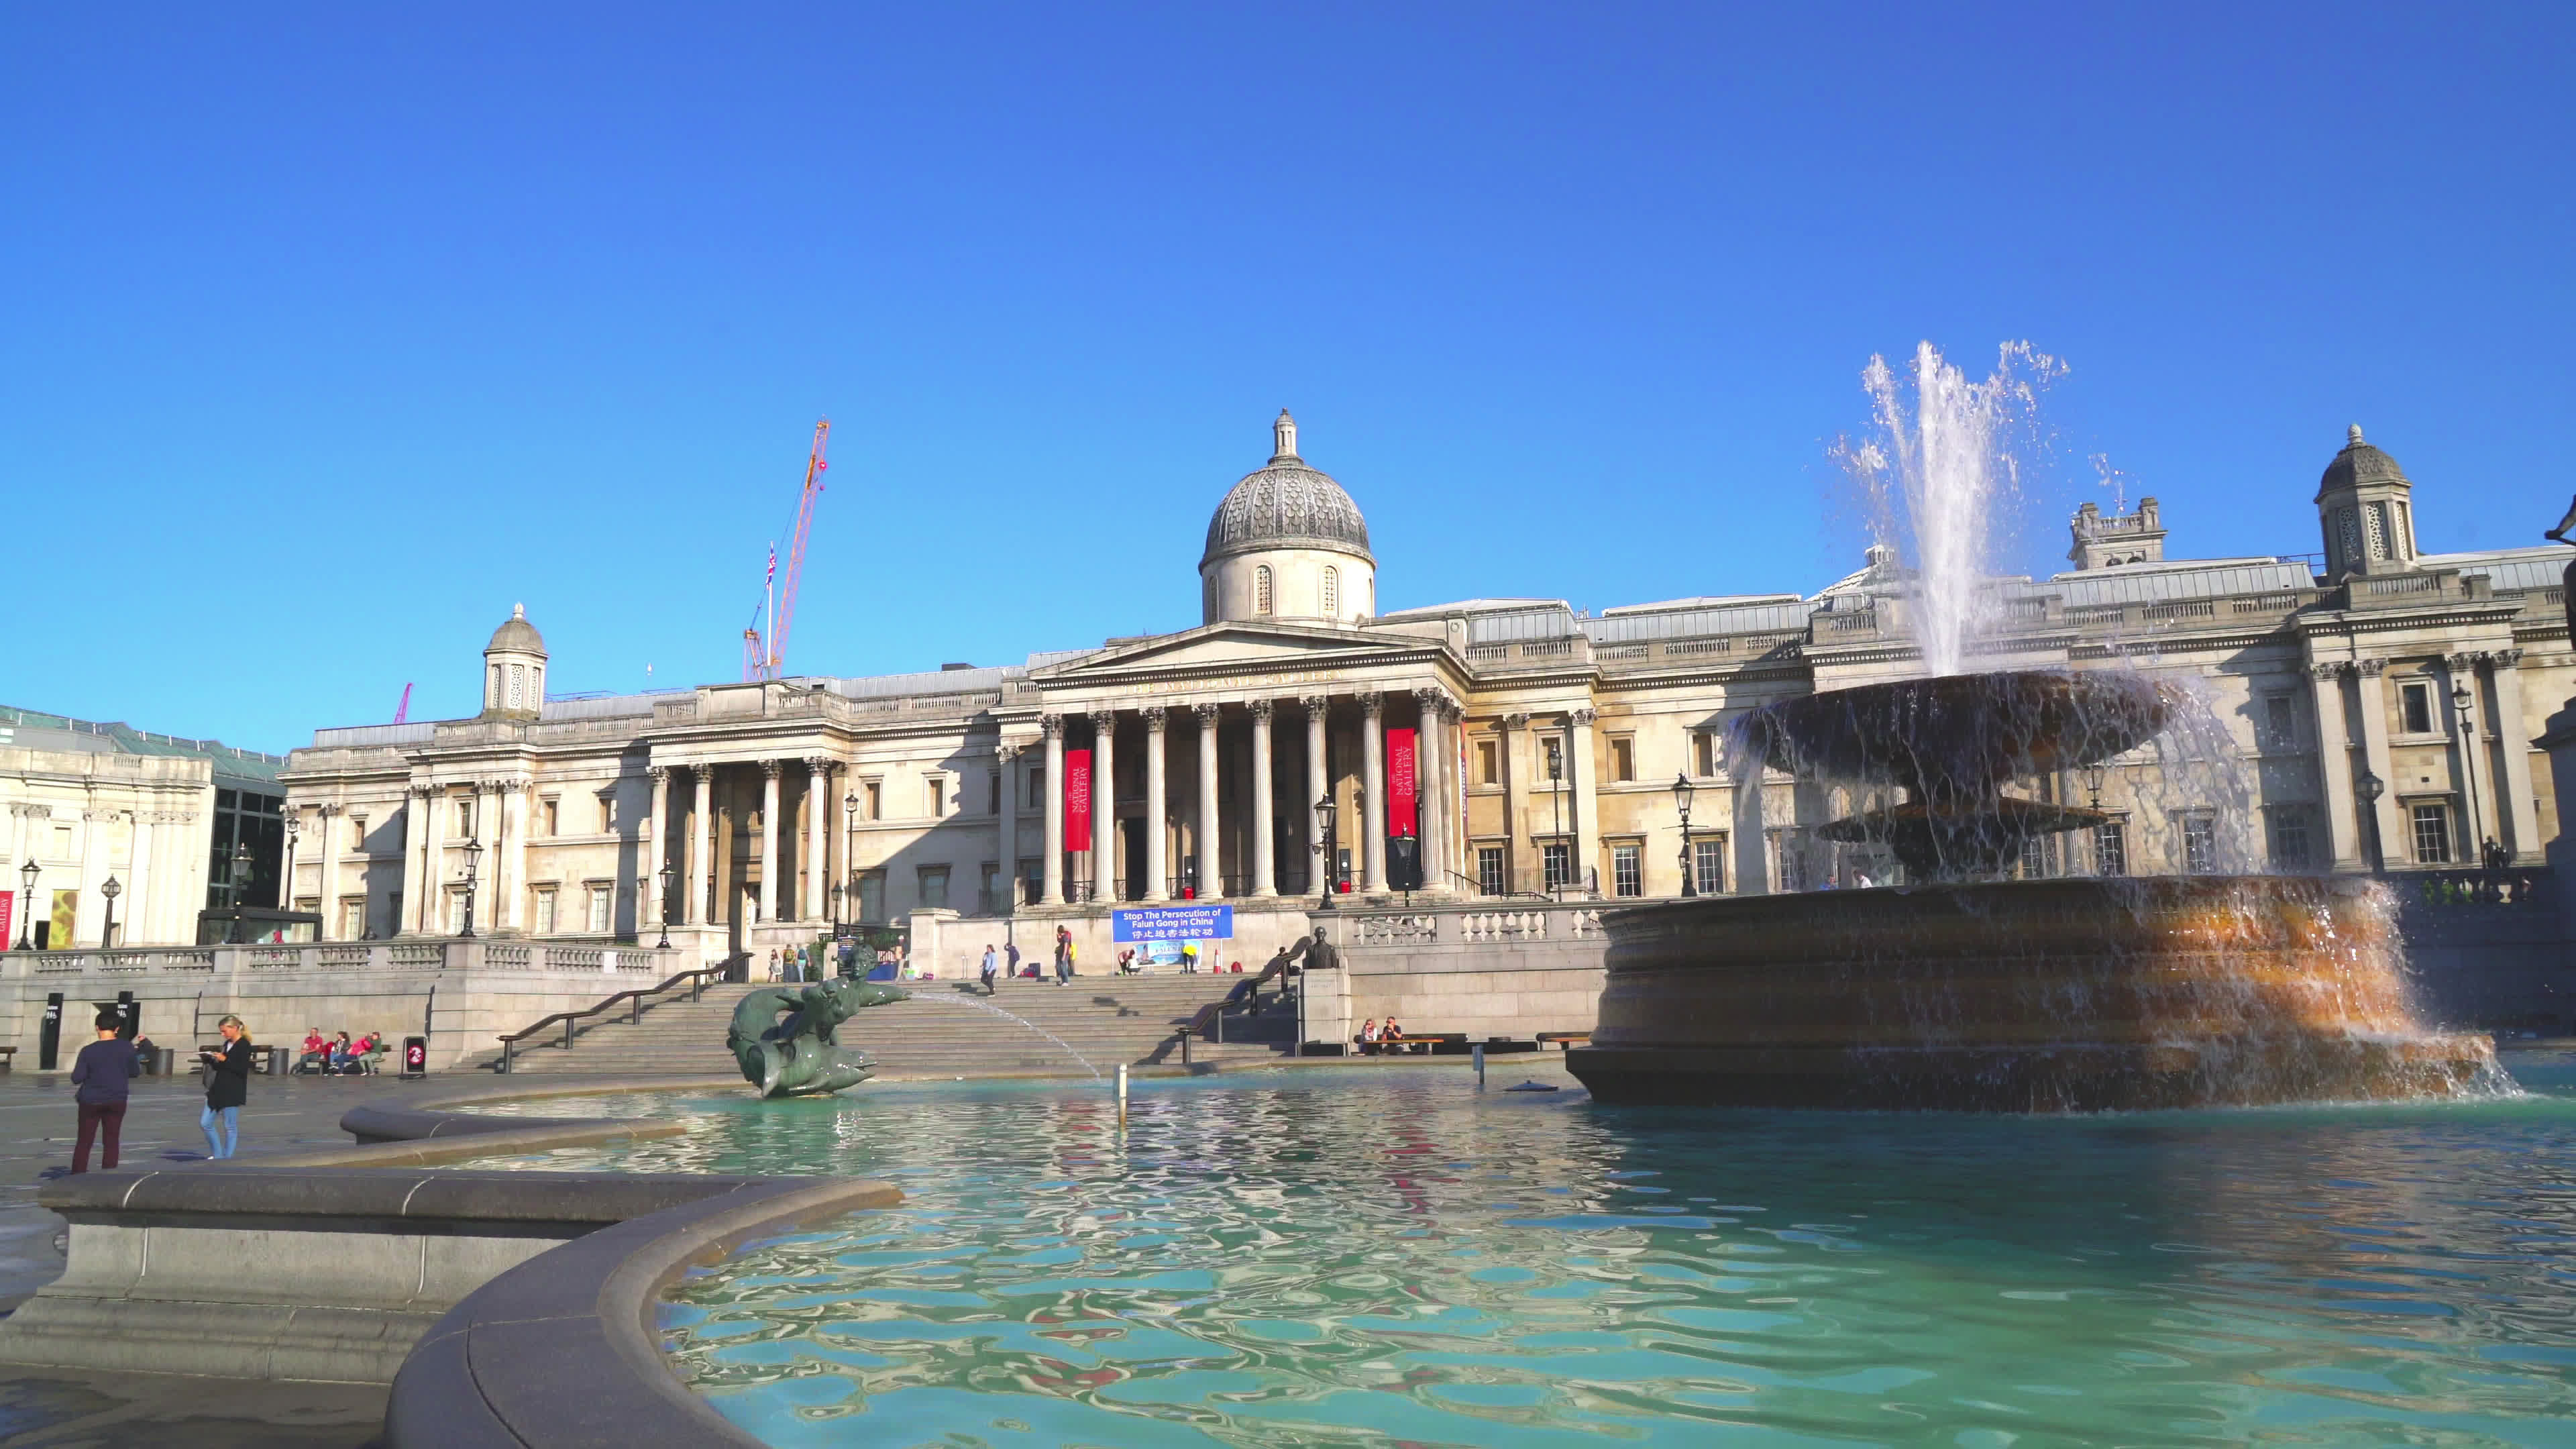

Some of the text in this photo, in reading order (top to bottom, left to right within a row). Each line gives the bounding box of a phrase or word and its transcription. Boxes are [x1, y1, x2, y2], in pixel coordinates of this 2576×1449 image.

[1403, 747, 1412, 796] GALLERY
[1079, 767, 1087, 813] GALLERY
[1124, 912, 1143, 921] Stop
[1162, 909, 1210, 918] Persecution
[1212, 908, 1221, 916] of
[1132, 917, 1214, 928] Falun Gong in China
